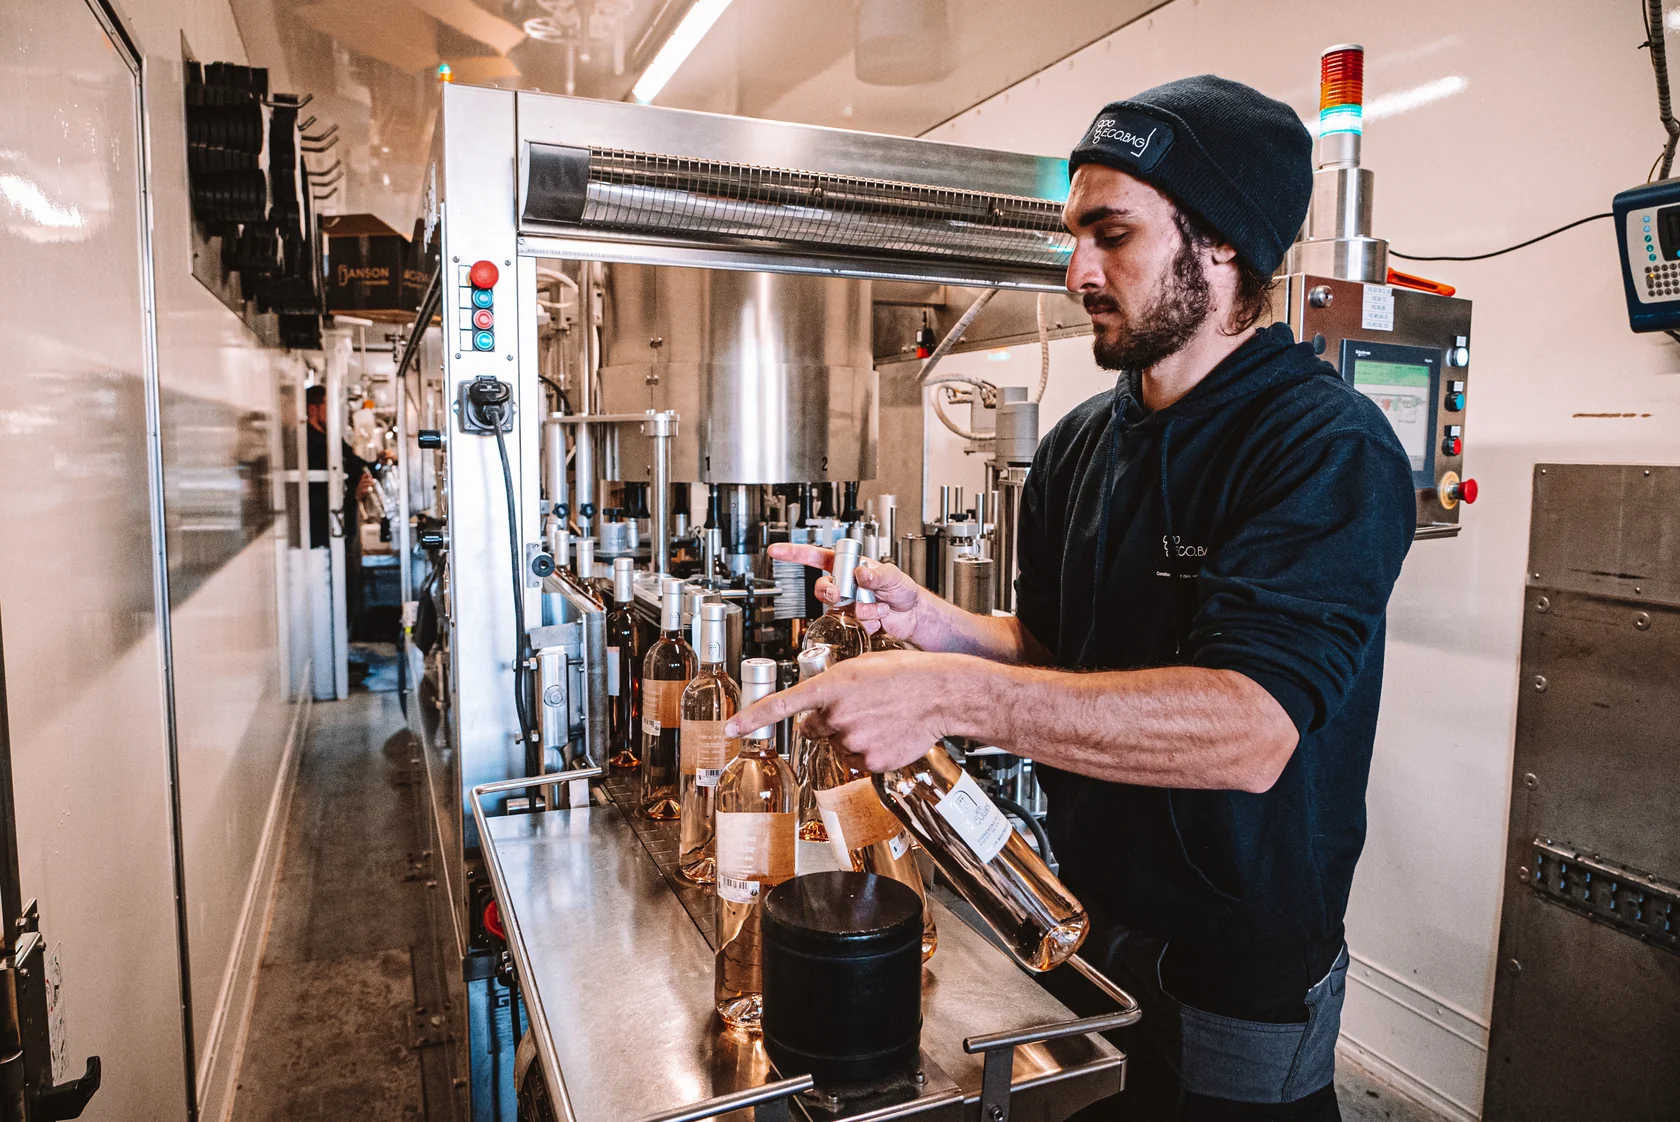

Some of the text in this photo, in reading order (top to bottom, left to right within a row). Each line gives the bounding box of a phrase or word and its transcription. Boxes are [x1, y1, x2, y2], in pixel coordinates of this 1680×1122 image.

[1100, 128, 1145, 148] ECO.BAG
[705, 456, 710, 471] 1
[821, 456, 828, 471] 2
